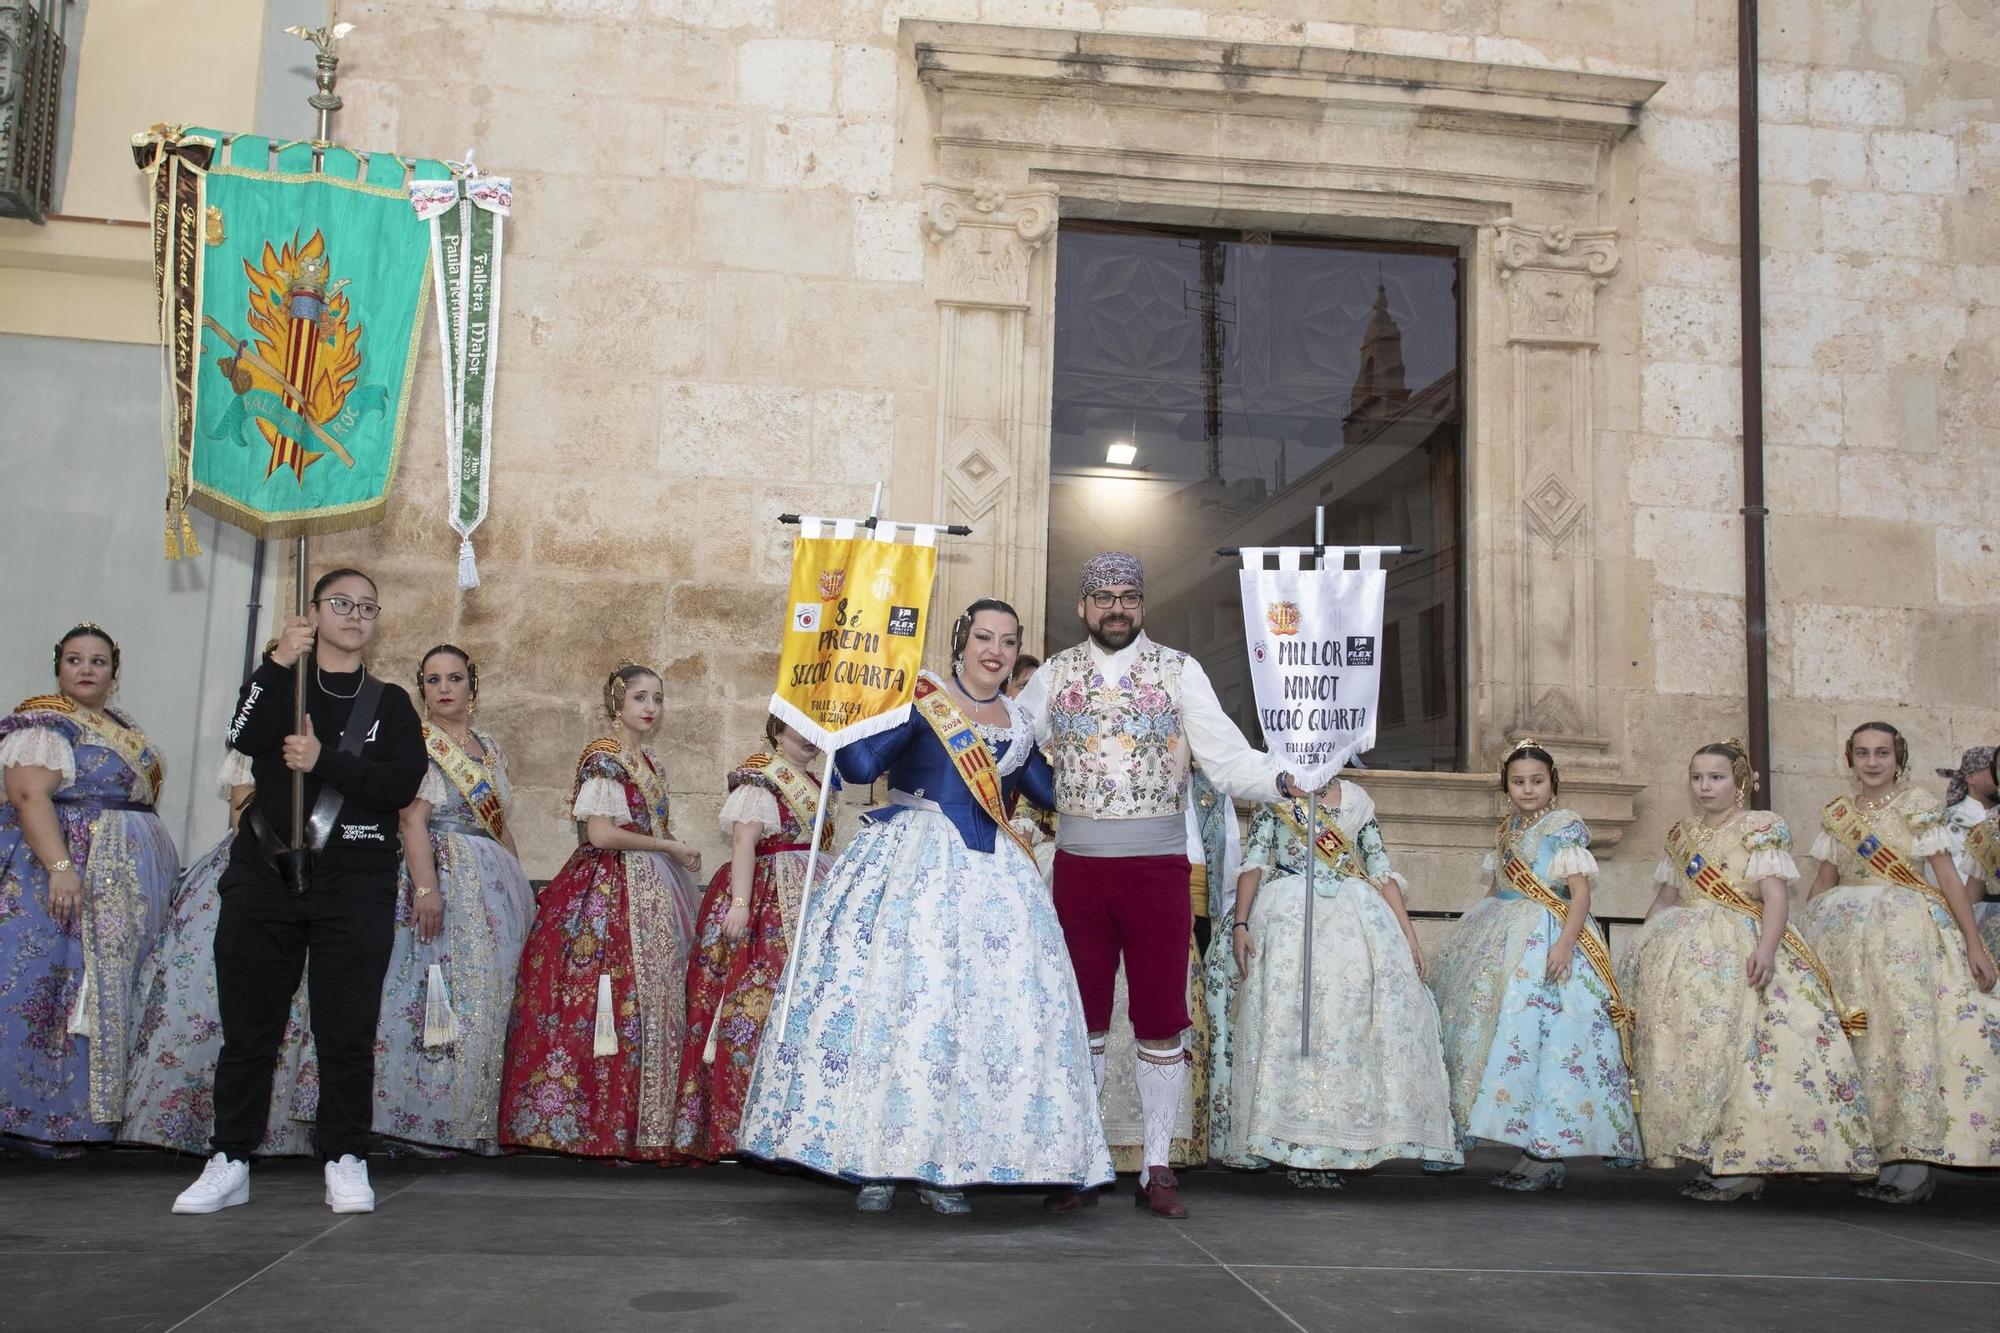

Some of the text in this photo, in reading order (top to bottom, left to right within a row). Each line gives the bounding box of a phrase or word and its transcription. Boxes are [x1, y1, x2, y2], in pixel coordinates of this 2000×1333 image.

[445, 234, 460, 275] Paula
[177, 203, 196, 373] Fallera Major
[468, 253, 487, 376] Fallera Major
[332, 406, 360, 435] ROC
[835, 598, 848, 625] 8
[890, 620, 915, 628] FLEX
[818, 629, 879, 653] PREMI
[1278, 640, 1343, 667] MILLOR
[1348, 650, 1373, 658] FLEX
[791, 655, 905, 692] SECCIÓ QUARTA
[242, 682, 263, 715] JEAN
[1284, 676, 1340, 701] NINOT
[811, 700, 837, 712] FALLES
[1308, 707, 1366, 732] QUARTA
[1285, 742, 1314, 753] FALLES
